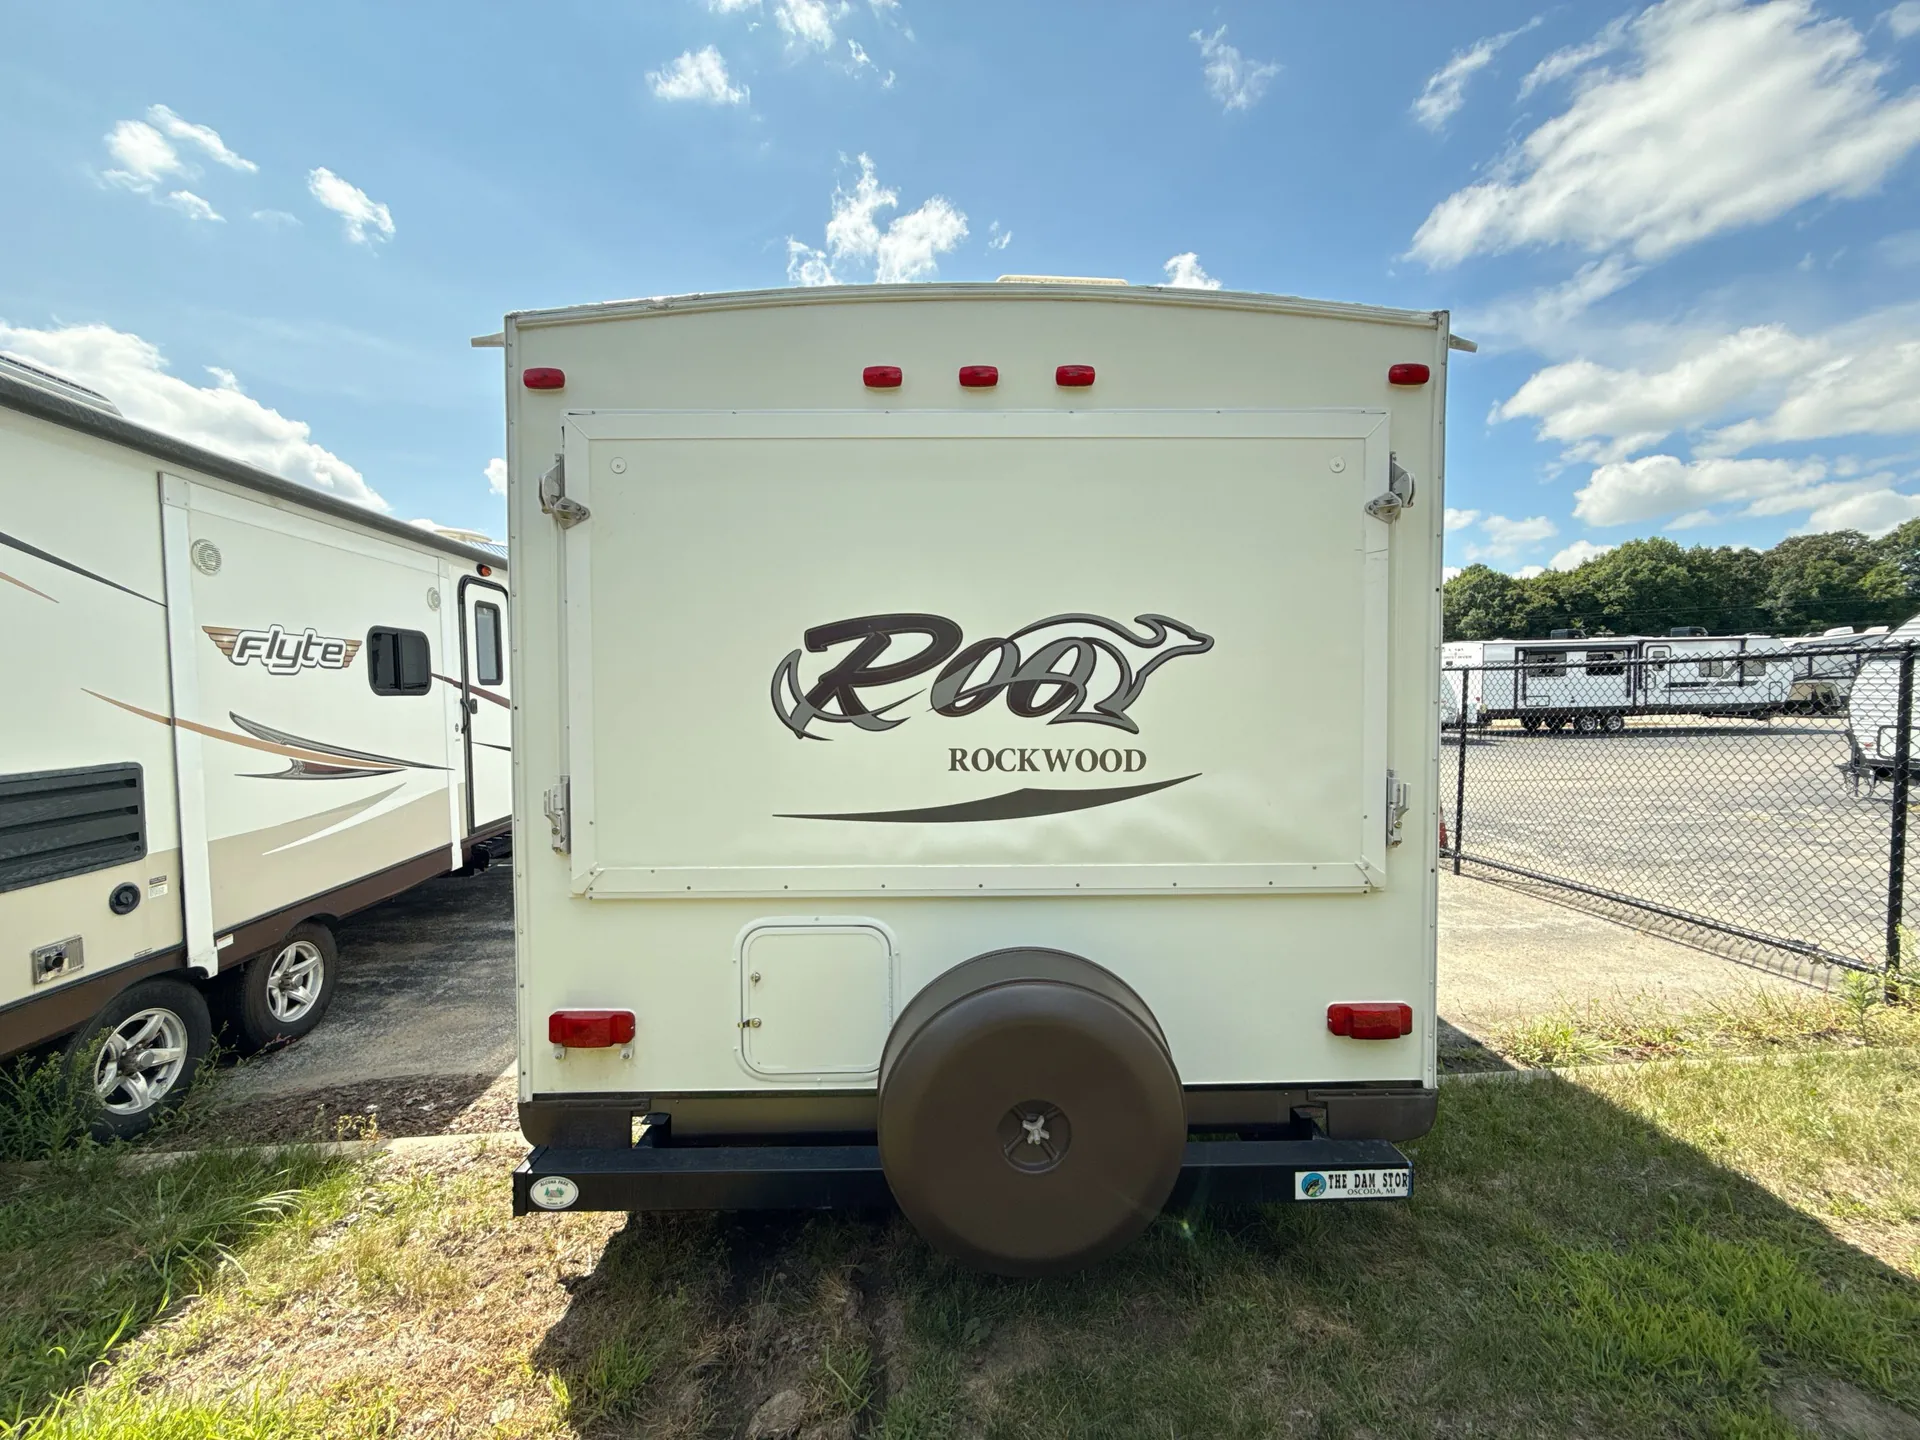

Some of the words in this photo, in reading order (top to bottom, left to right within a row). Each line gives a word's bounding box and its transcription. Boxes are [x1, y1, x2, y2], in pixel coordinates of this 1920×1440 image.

[947, 746, 1147, 774] ROCKWOOD
[1328, 1173, 1347, 1189] THE
[1354, 1172, 1376, 1189] DAM
[1383, 1172, 1410, 1188] STOR
[1347, 1188, 1384, 1196] OSCODA,
[1386, 1187, 1396, 1195] MI
